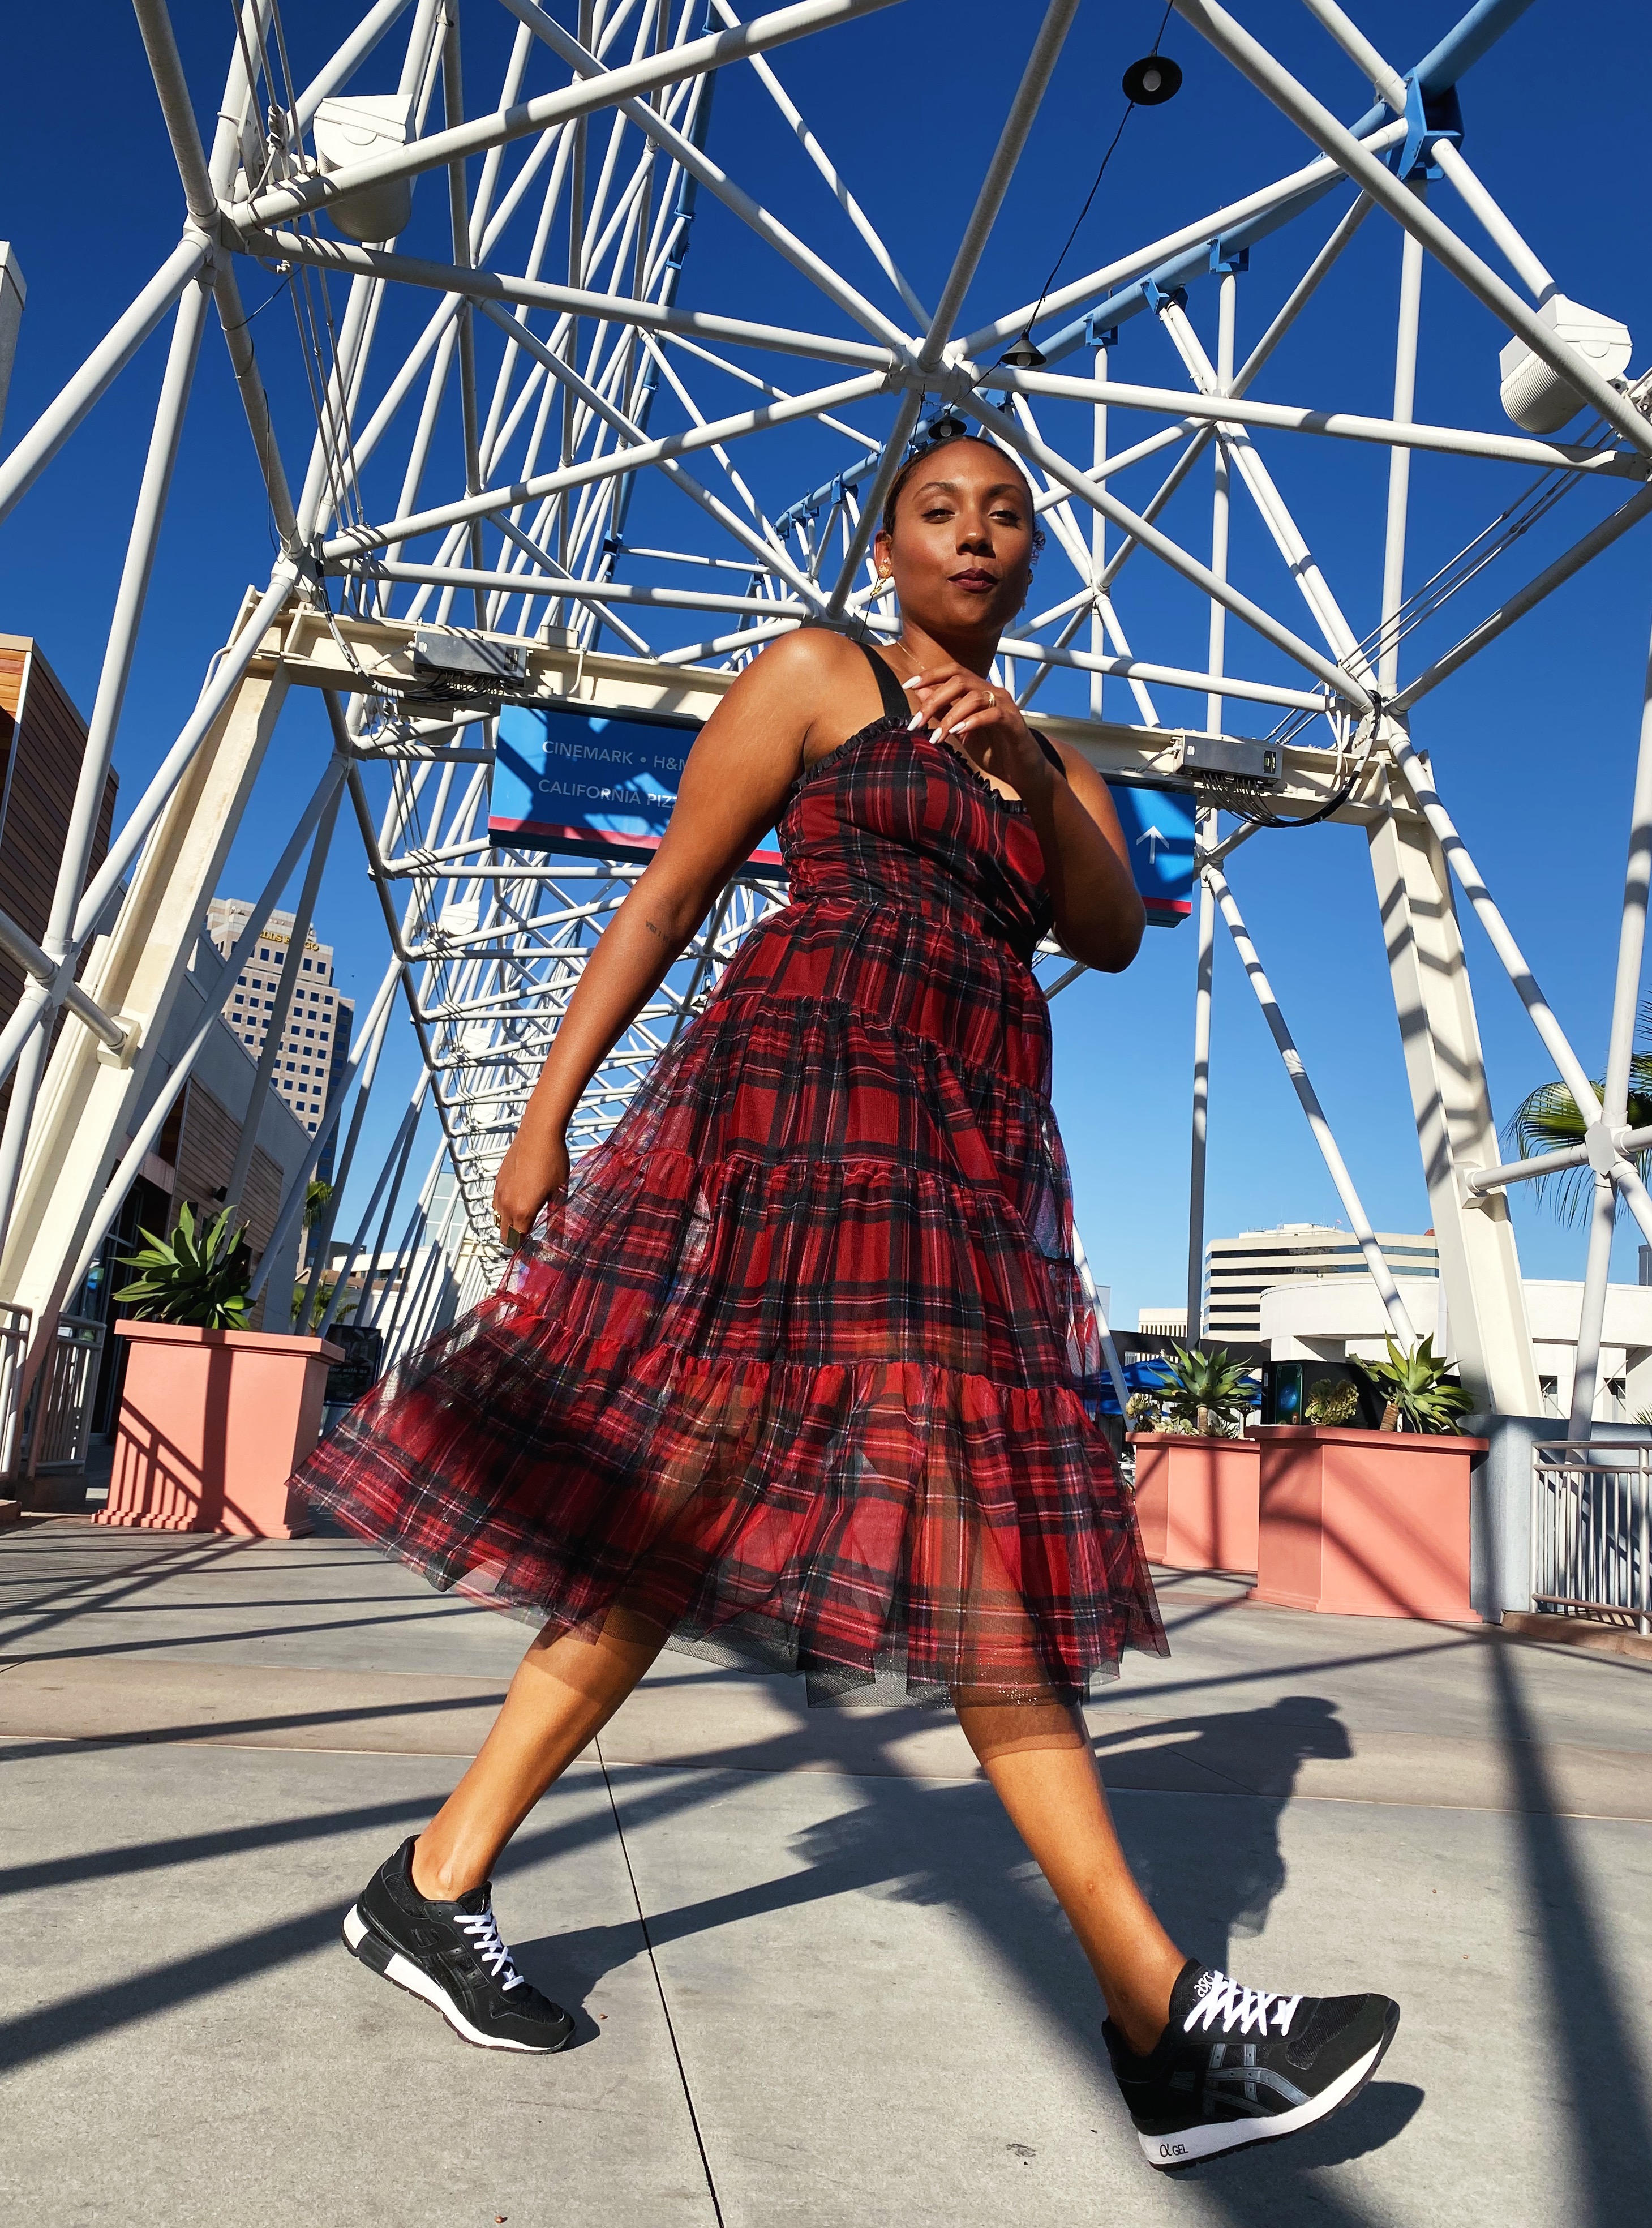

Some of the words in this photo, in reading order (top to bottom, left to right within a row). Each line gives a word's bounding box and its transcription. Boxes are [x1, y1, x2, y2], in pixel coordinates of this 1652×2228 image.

[542, 740, 634, 765] CINEMARK
[538, 779, 641, 805] CALIFORNIA
[1172, 2144, 1189, 2156] GEL
